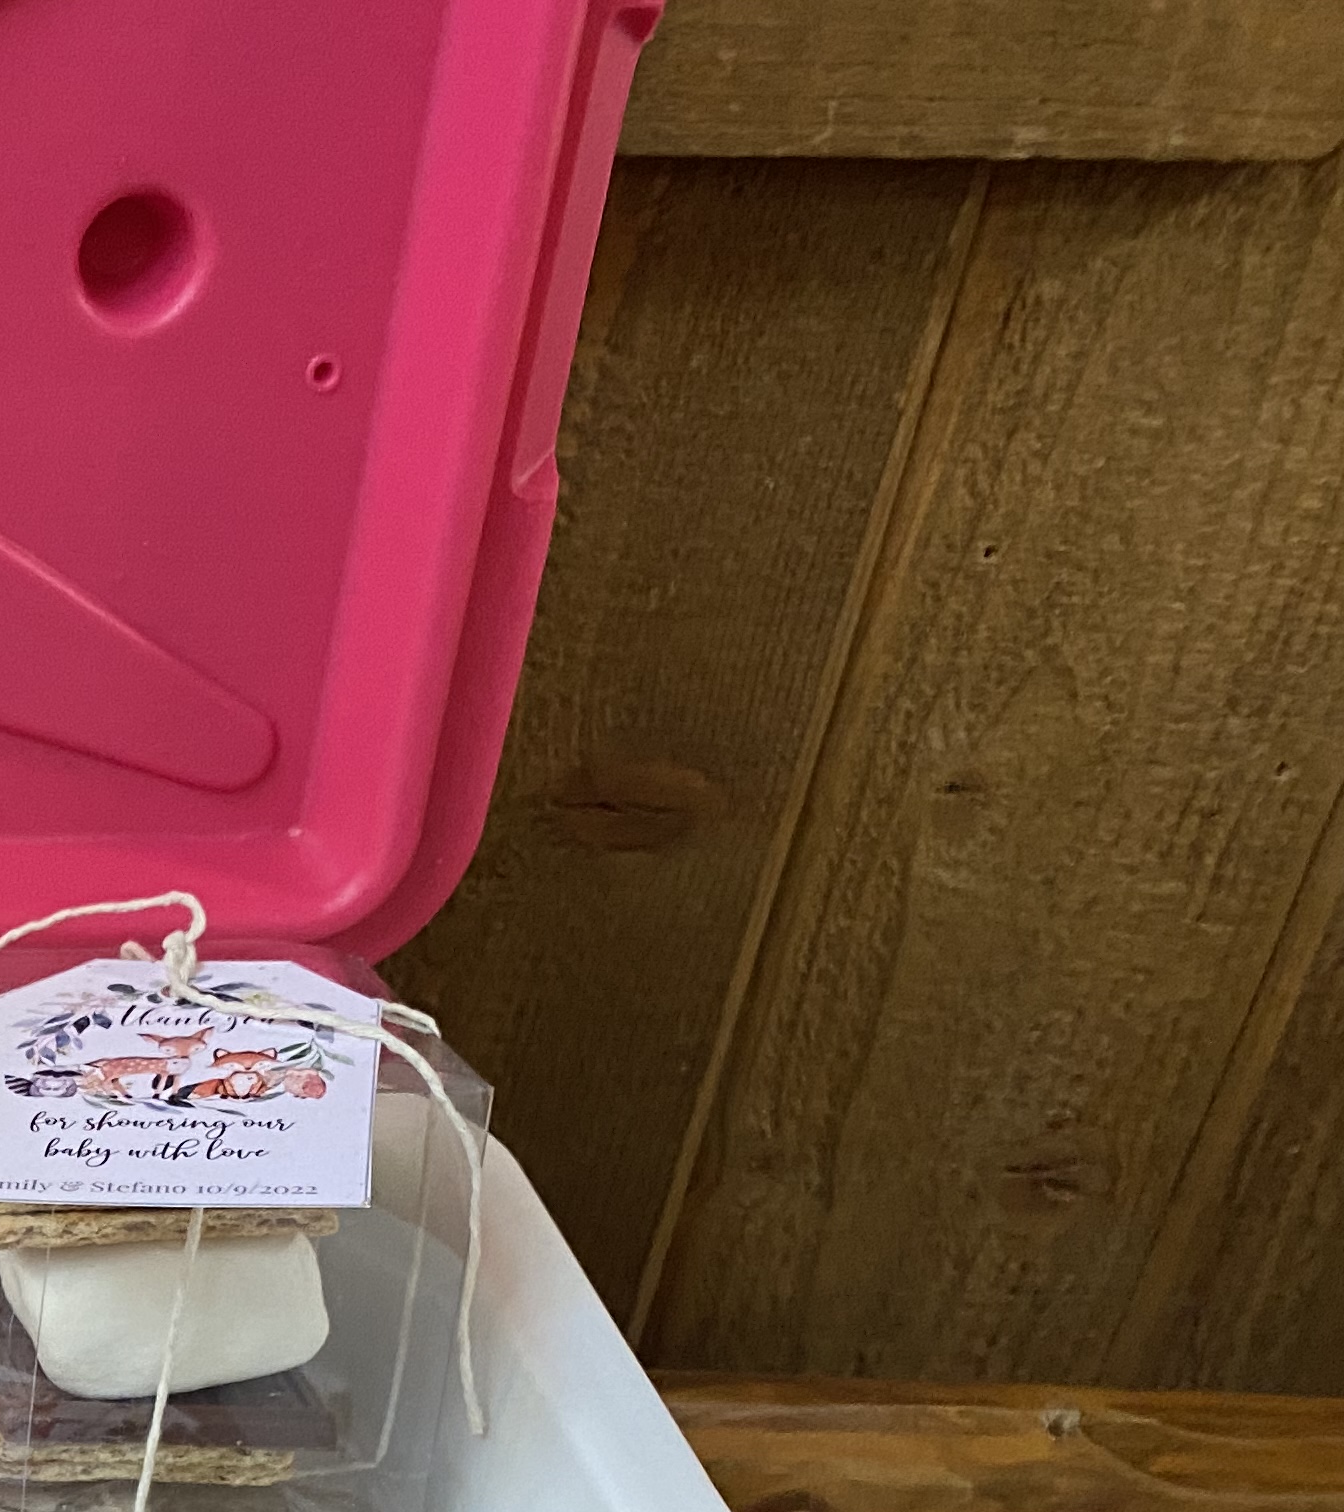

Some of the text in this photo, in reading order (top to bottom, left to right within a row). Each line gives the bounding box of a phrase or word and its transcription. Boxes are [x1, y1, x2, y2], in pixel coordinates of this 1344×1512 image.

[29, 1110, 296, 1138] for showering our
[44, 1137, 270, 1168] baby with love
[59, 1180, 85, 1193] &
[90, 1180, 187, 1196] Stefano
[194, 1181, 319, 1198] 10/9/2022
